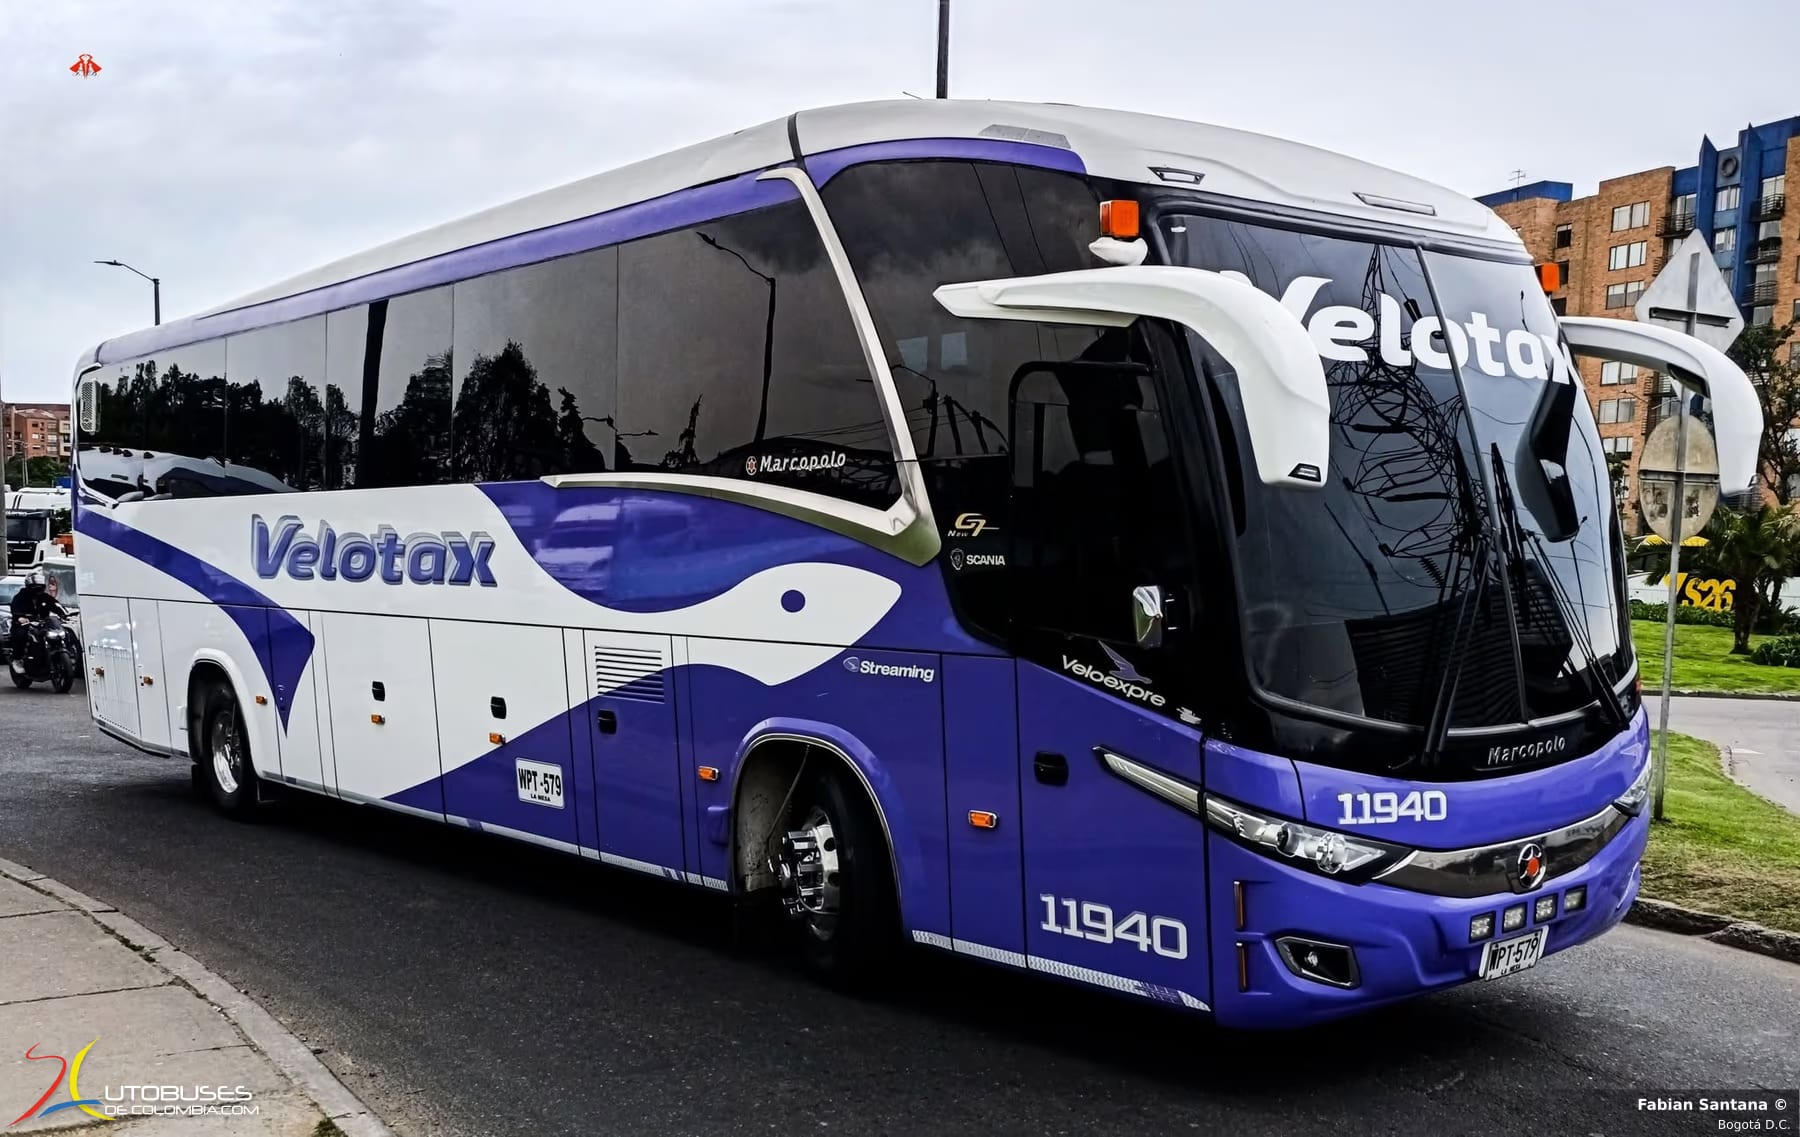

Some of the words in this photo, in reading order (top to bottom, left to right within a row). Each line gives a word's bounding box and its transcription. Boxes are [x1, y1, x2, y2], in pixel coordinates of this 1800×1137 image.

[760, 451, 846, 472] Marcopolo
[251, 513, 498, 587] Velotax
[966, 554, 1006, 566] SCANIA
[860, 660, 935, 682] Streaming
[1487, 735, 1566, 765] Marcopolo
[1338, 791, 1447, 825] 11940
[1040, 893, 1188, 960] 11940
